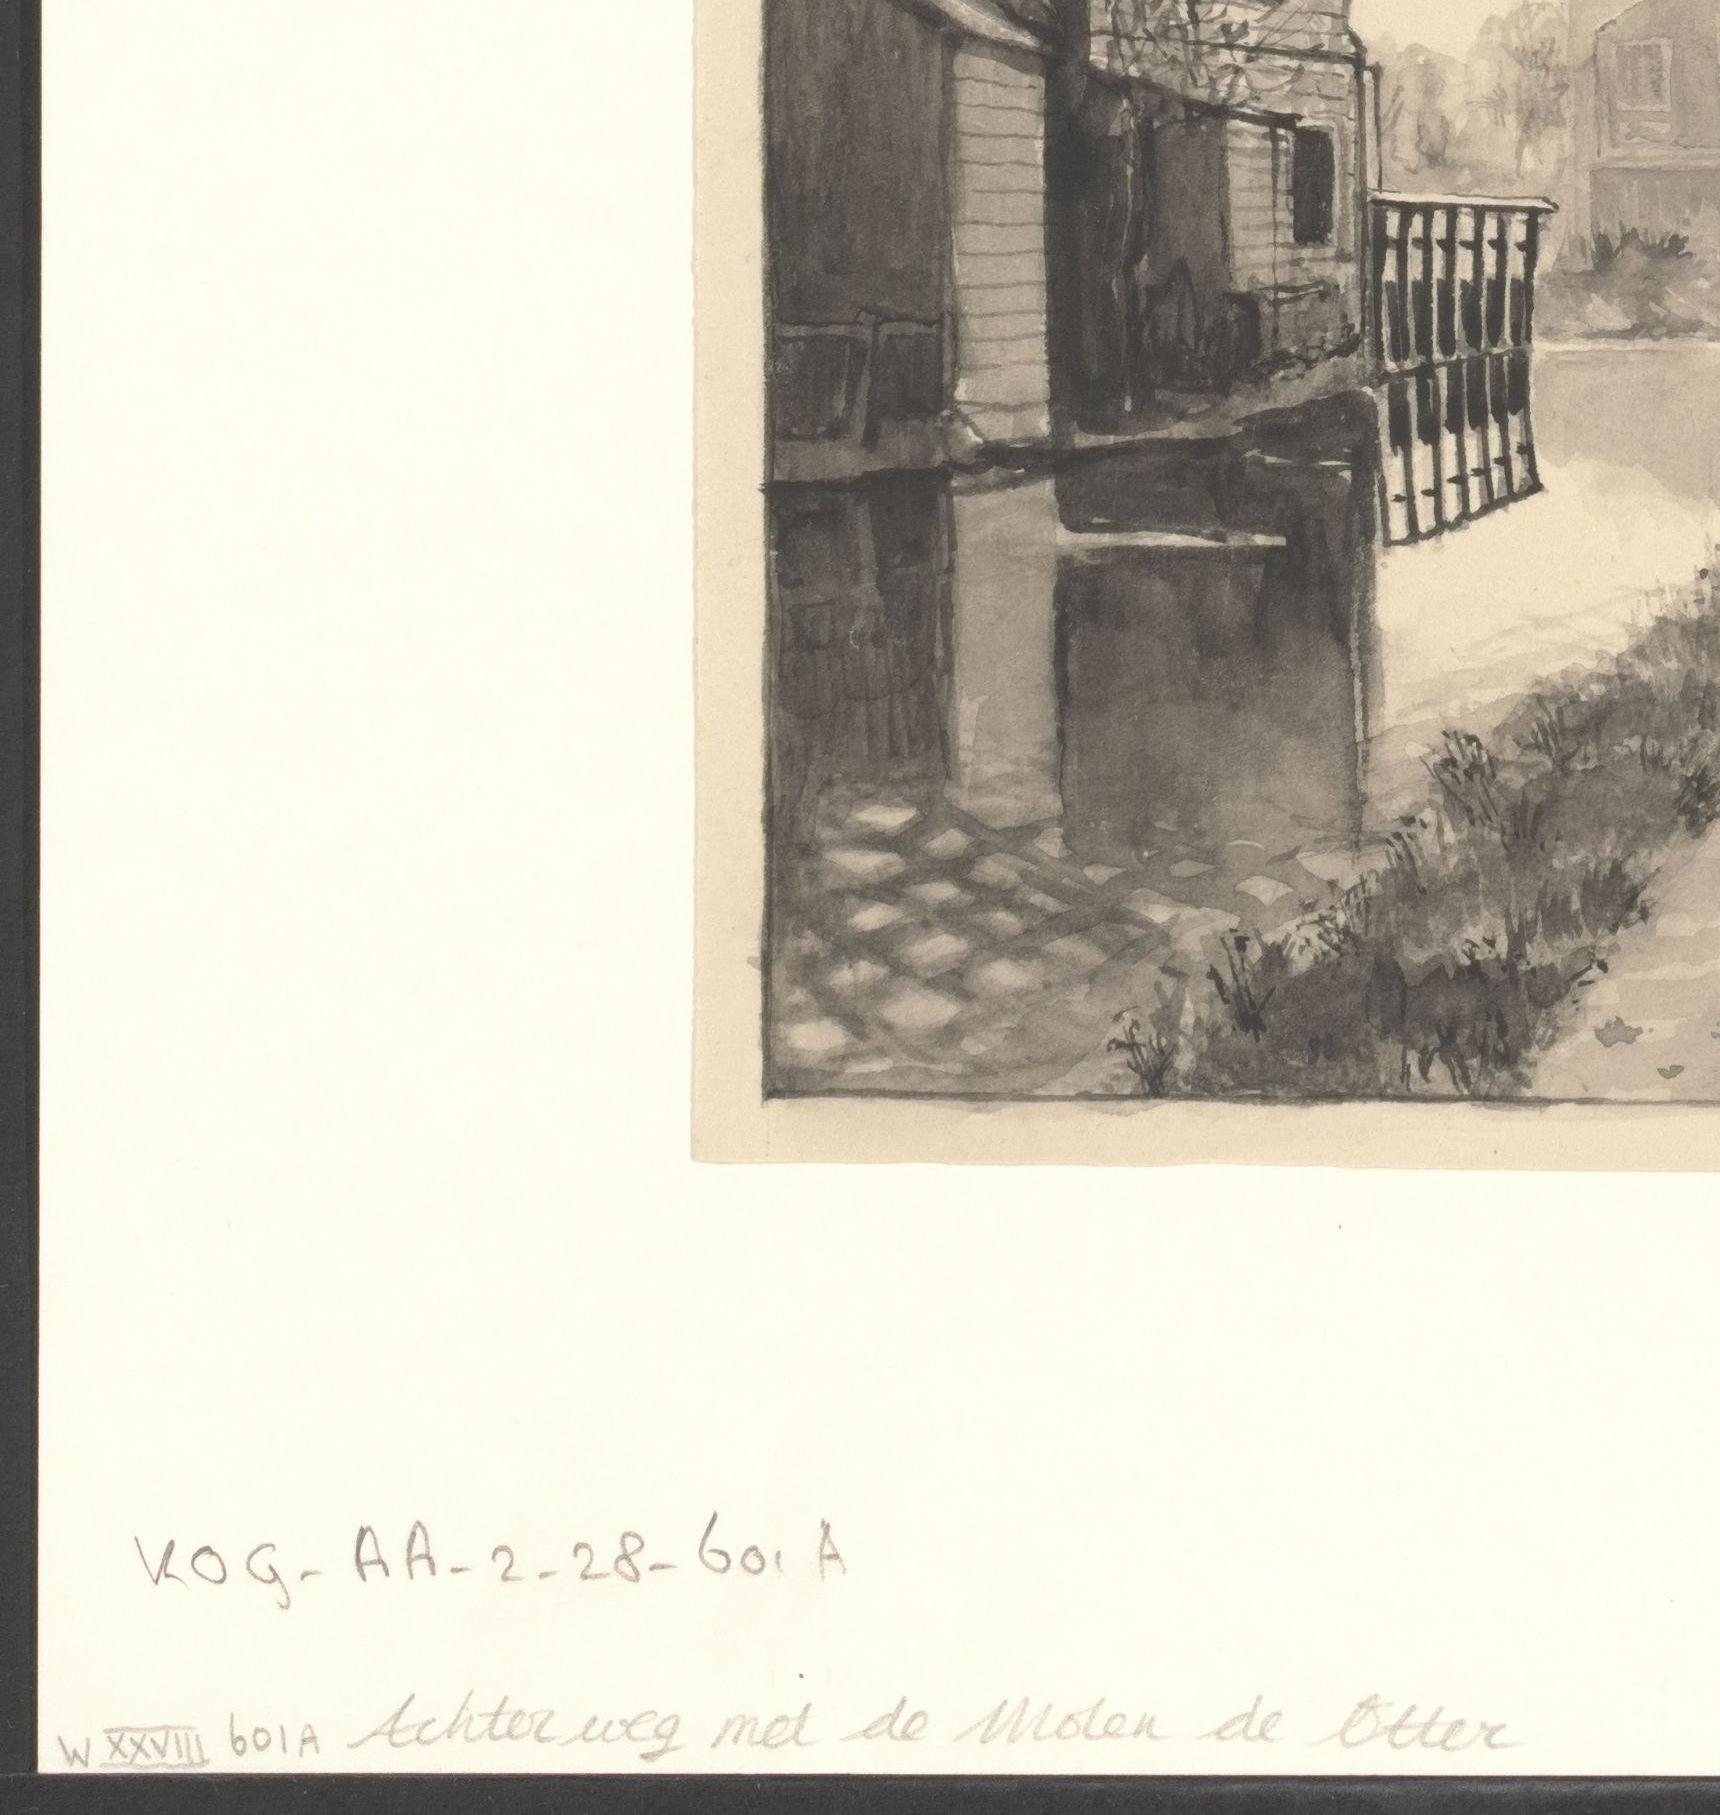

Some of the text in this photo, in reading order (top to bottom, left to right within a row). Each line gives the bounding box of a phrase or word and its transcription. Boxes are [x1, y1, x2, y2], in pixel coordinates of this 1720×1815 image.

[56, 1734, 91, 1768] W
[710, 1701, 820, 1750] met
[840, 1695, 930, 1743] de
[952, 1697, 1173, 1746] Molen
[1200, 1694, 1286, 1744] de
[1307, 1692, 1526, 1752] Otter
